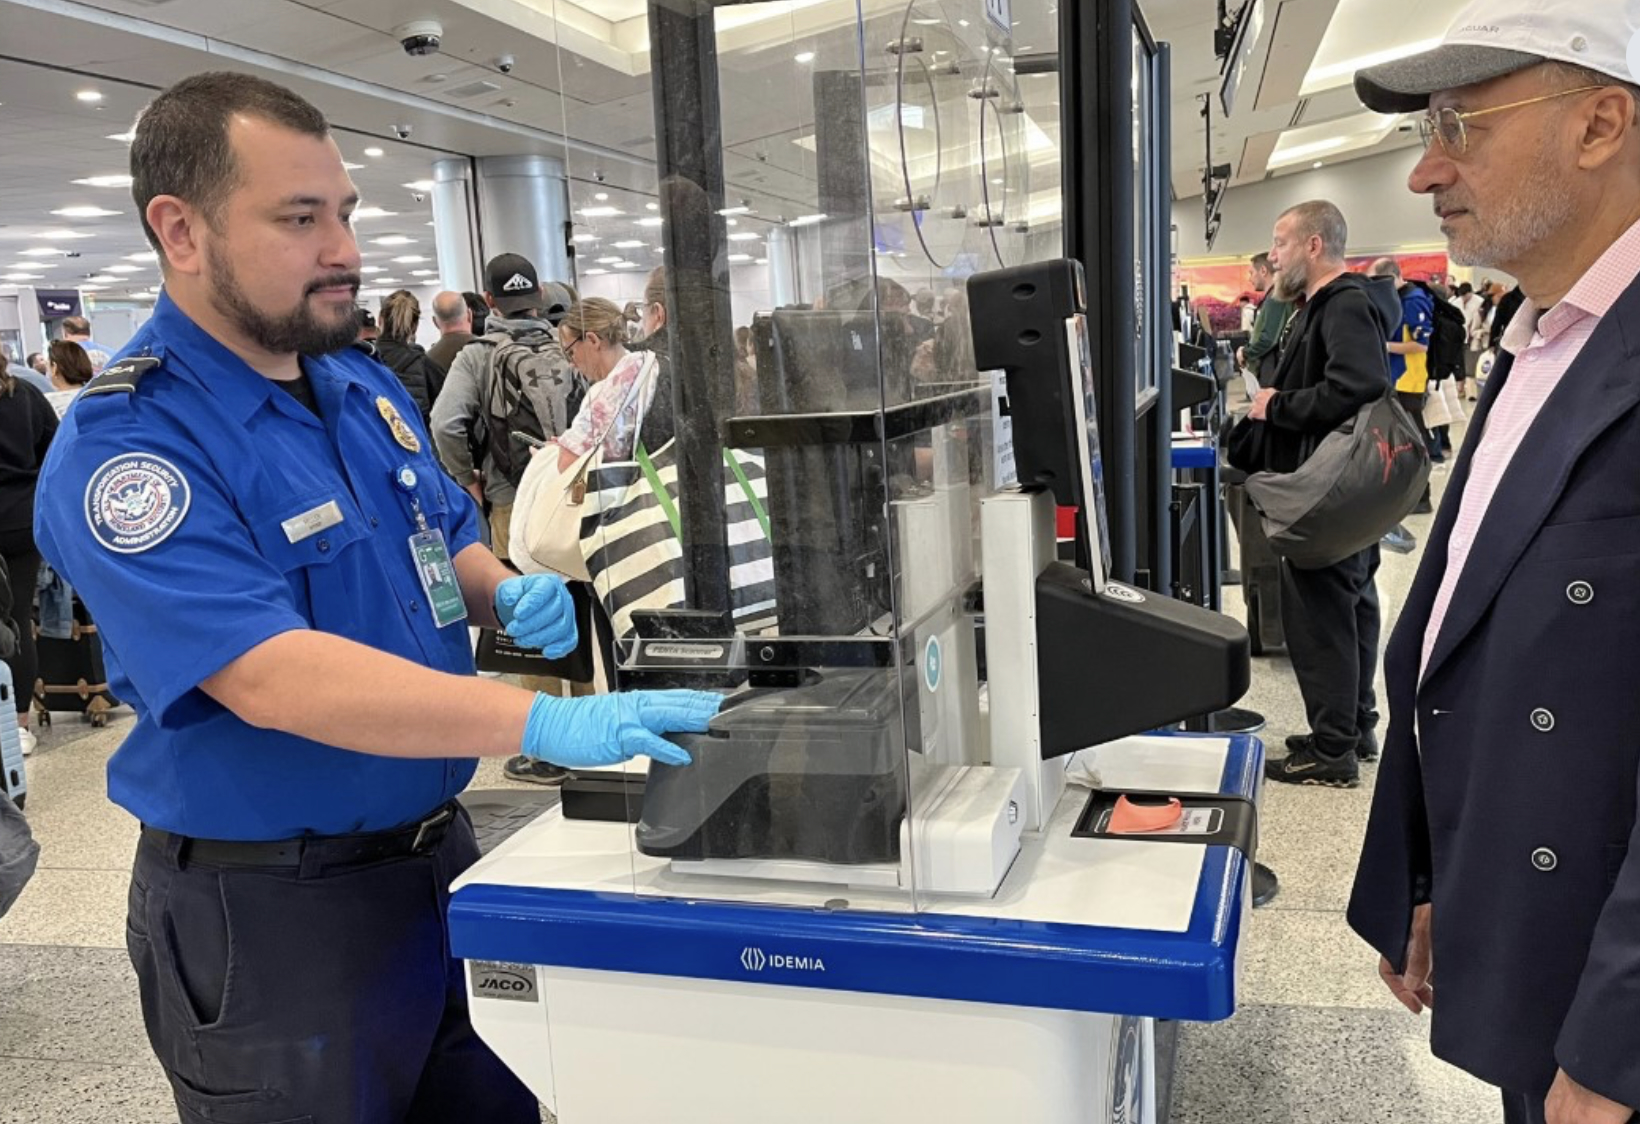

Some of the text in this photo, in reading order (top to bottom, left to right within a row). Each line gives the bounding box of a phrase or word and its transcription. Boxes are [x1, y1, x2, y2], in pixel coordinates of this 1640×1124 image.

[93, 462, 179, 526] TRANSPORTATION SECURITY
[112, 506, 179, 544] ADMINISTRATION
[769, 954, 826, 972] IDEMIA
[478, 978, 525, 992] JACO
